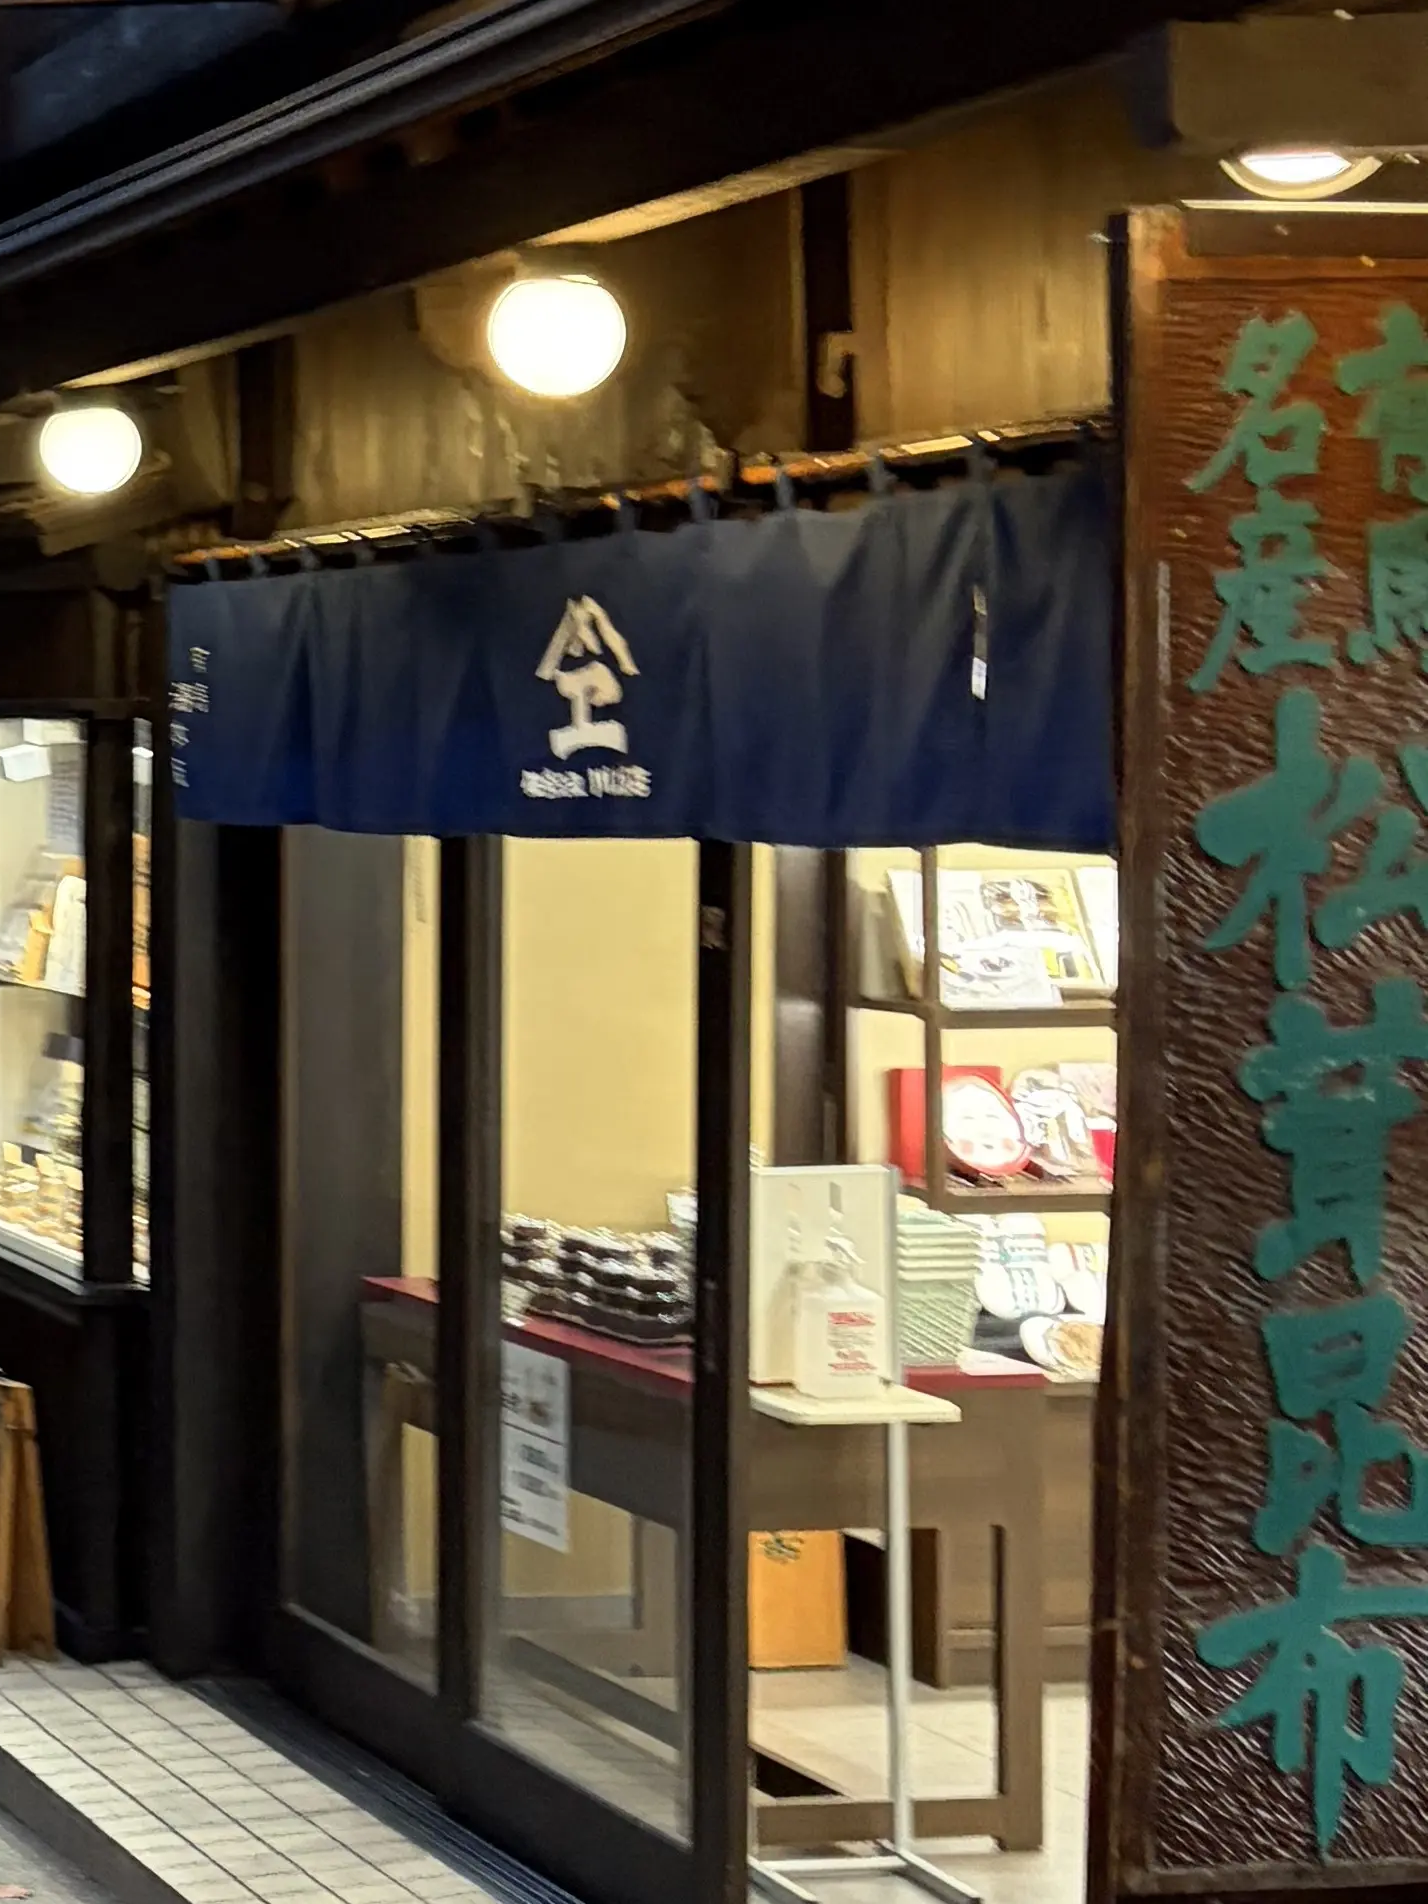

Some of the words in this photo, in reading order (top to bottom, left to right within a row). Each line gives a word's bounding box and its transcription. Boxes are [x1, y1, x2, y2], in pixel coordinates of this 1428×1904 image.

[1183, 308, 1336, 693] 名産
[1194, 684, 1428, 1862] 松茸昆布
